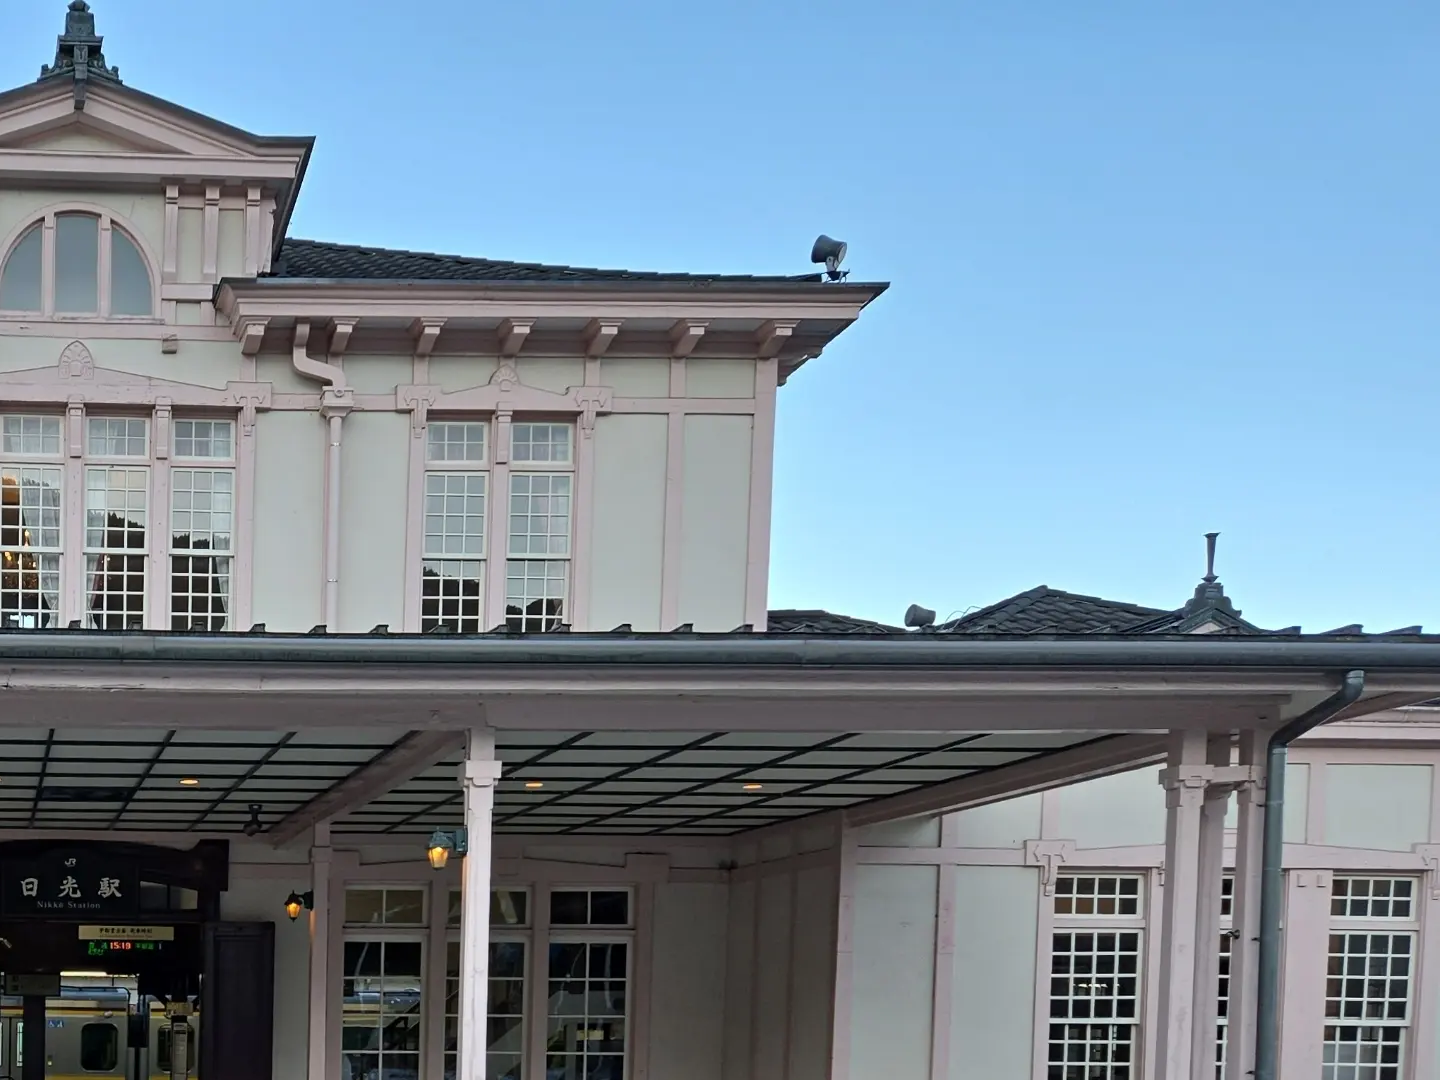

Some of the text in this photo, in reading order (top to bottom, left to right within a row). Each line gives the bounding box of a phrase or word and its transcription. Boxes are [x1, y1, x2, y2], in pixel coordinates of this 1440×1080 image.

[64, 858, 77, 867] JR
[20, 876, 122, 898] 日光駅
[67, 900, 101, 909] Station
